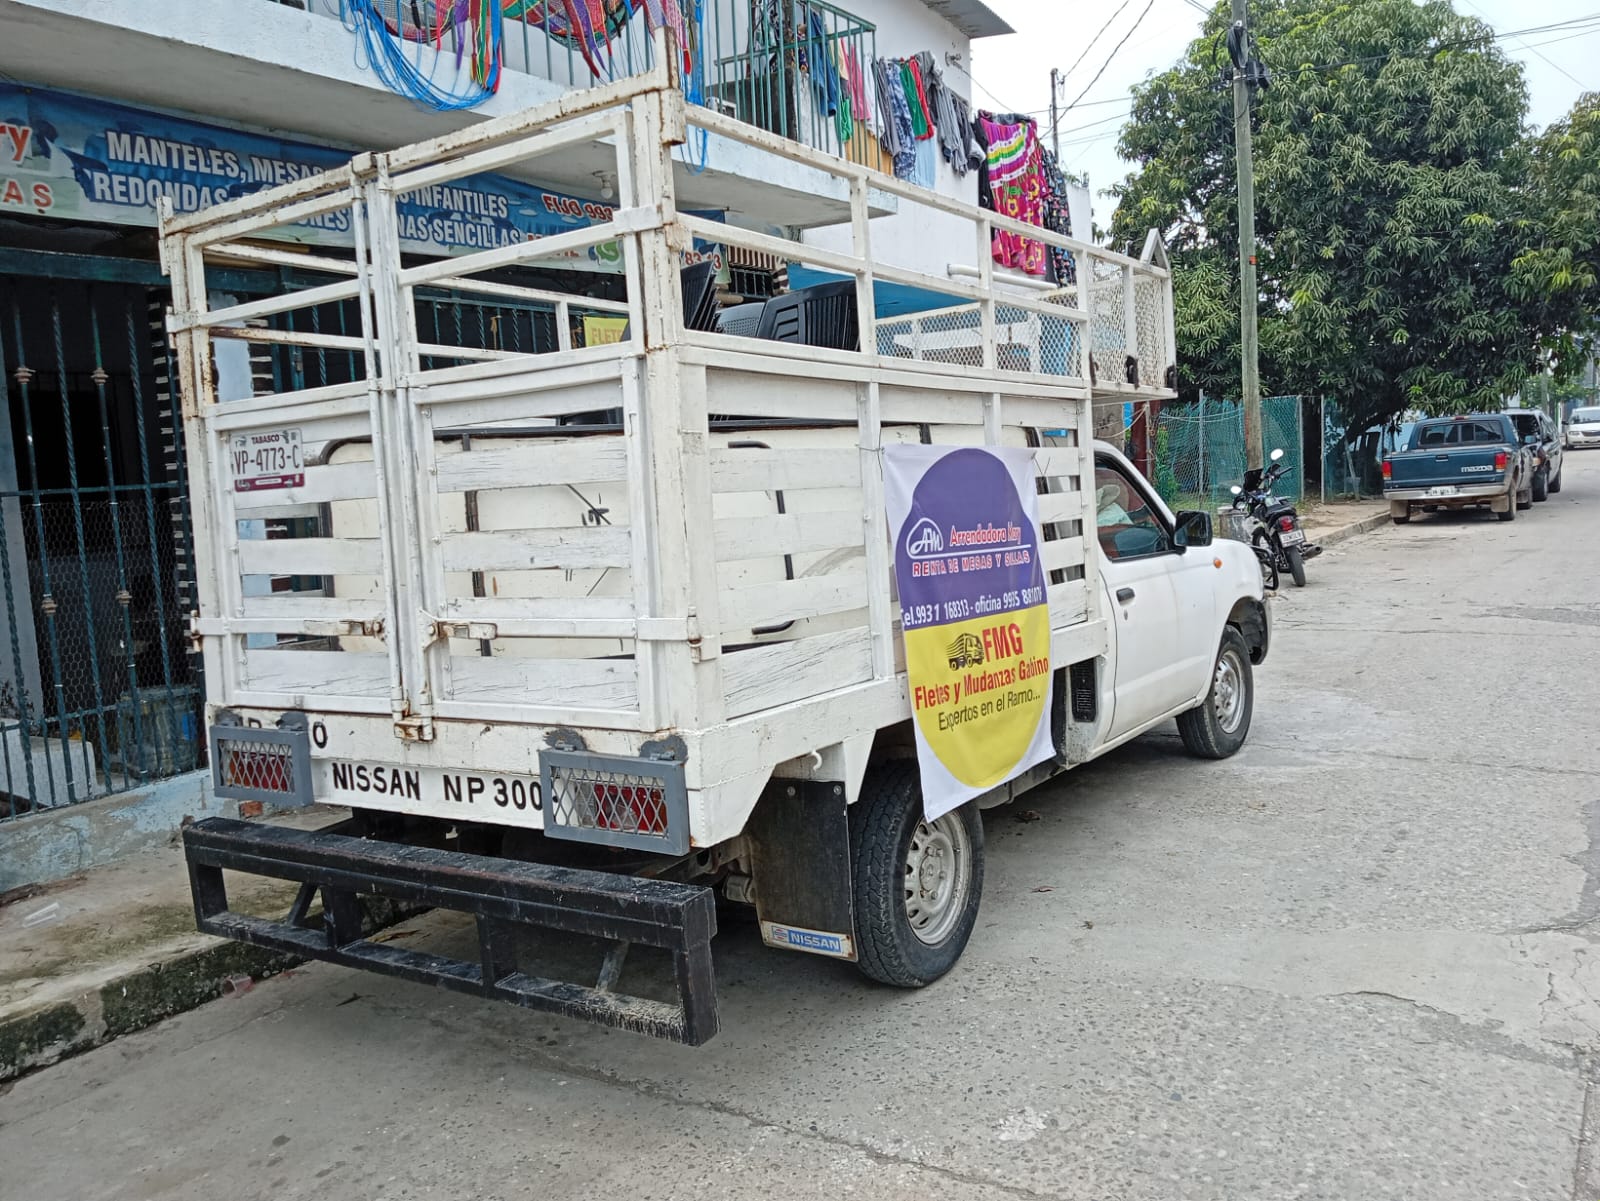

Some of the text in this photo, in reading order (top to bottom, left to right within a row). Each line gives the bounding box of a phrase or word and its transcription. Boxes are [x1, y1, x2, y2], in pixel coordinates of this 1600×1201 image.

[107, 131, 246, 183] MANTELES,
[415, 185, 509, 219] INFANTILES
[542, 194, 583, 217] FIJO
[431, 218, 520, 248] SENCILLAS
[251, 434, 280, 444] TABASCO
[234, 445, 300, 475] VP-4773-C
[949, 523, 1006, 547] Arrendadora
[912, 550, 1031, 577] RENTA DE MESAS Y SILLAS
[975, 594, 1001, 613] oficina
[982, 623, 1024, 662] FMG
[914, 656, 1049, 711] Fletes y Mudanzas Gabino
[938, 705, 979, 732] Expertos
[981, 703, 994, 717] en
[996, 697, 1005, 712] el
[332, 762, 421, 801] NISSAN
[790, 932, 840, 950] NISSAN
